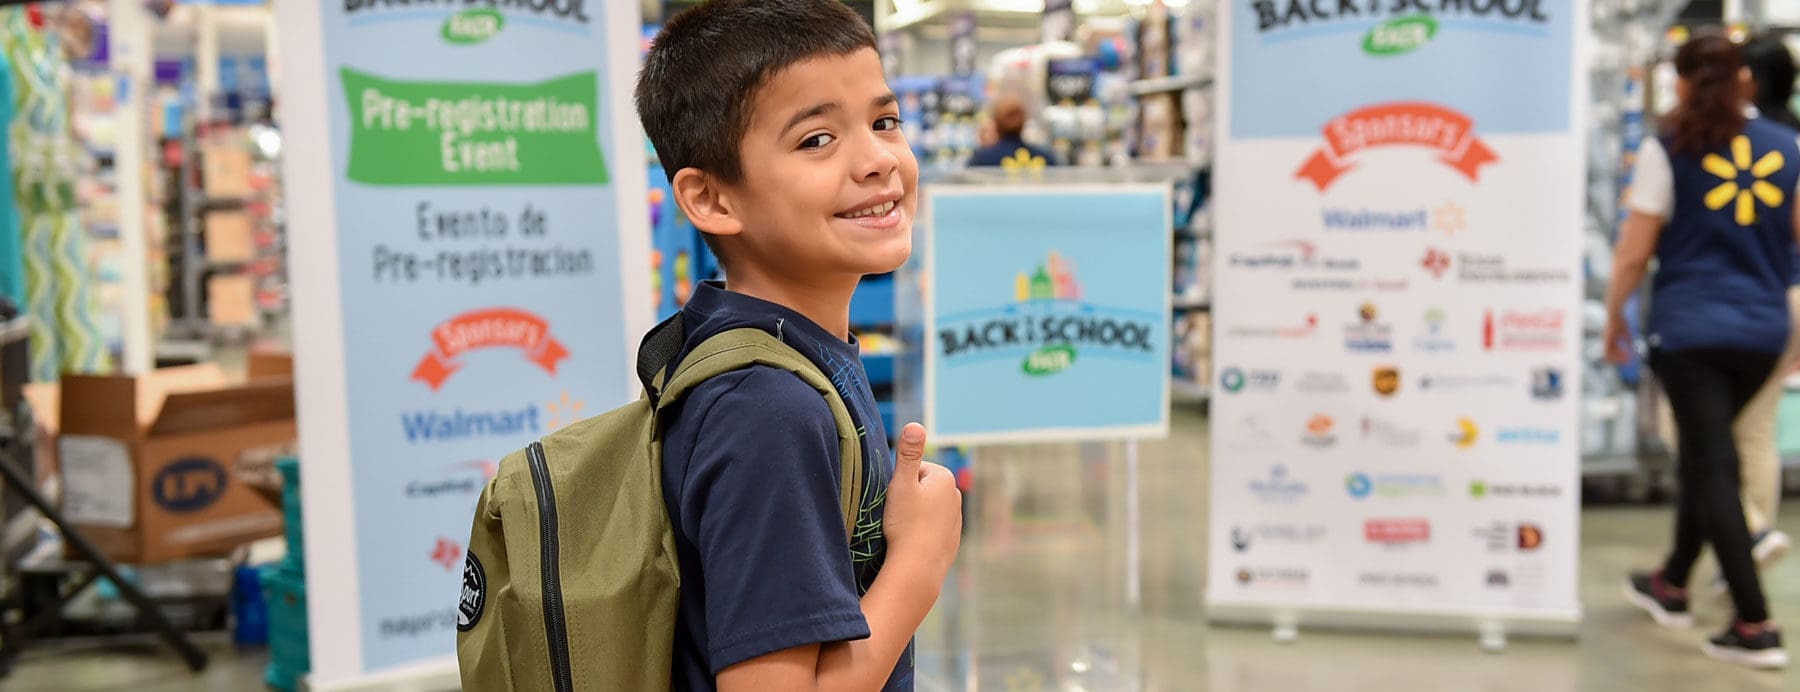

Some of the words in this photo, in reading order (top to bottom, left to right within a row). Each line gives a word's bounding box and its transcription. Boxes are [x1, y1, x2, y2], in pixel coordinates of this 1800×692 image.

[361, 88, 589, 134] Pre-registration
[440, 130, 519, 171] Event
[1333, 114, 1458, 151] Sponsors
[415, 201, 508, 240] Evento
[518, 203, 548, 236] de
[371, 244, 594, 286] Pre-registracion
[440, 318, 539, 352] Sponsors
[939, 319, 1019, 356] BACK
[1040, 317, 1153, 353] SCHOOL
[401, 402, 539, 443] Walmart
